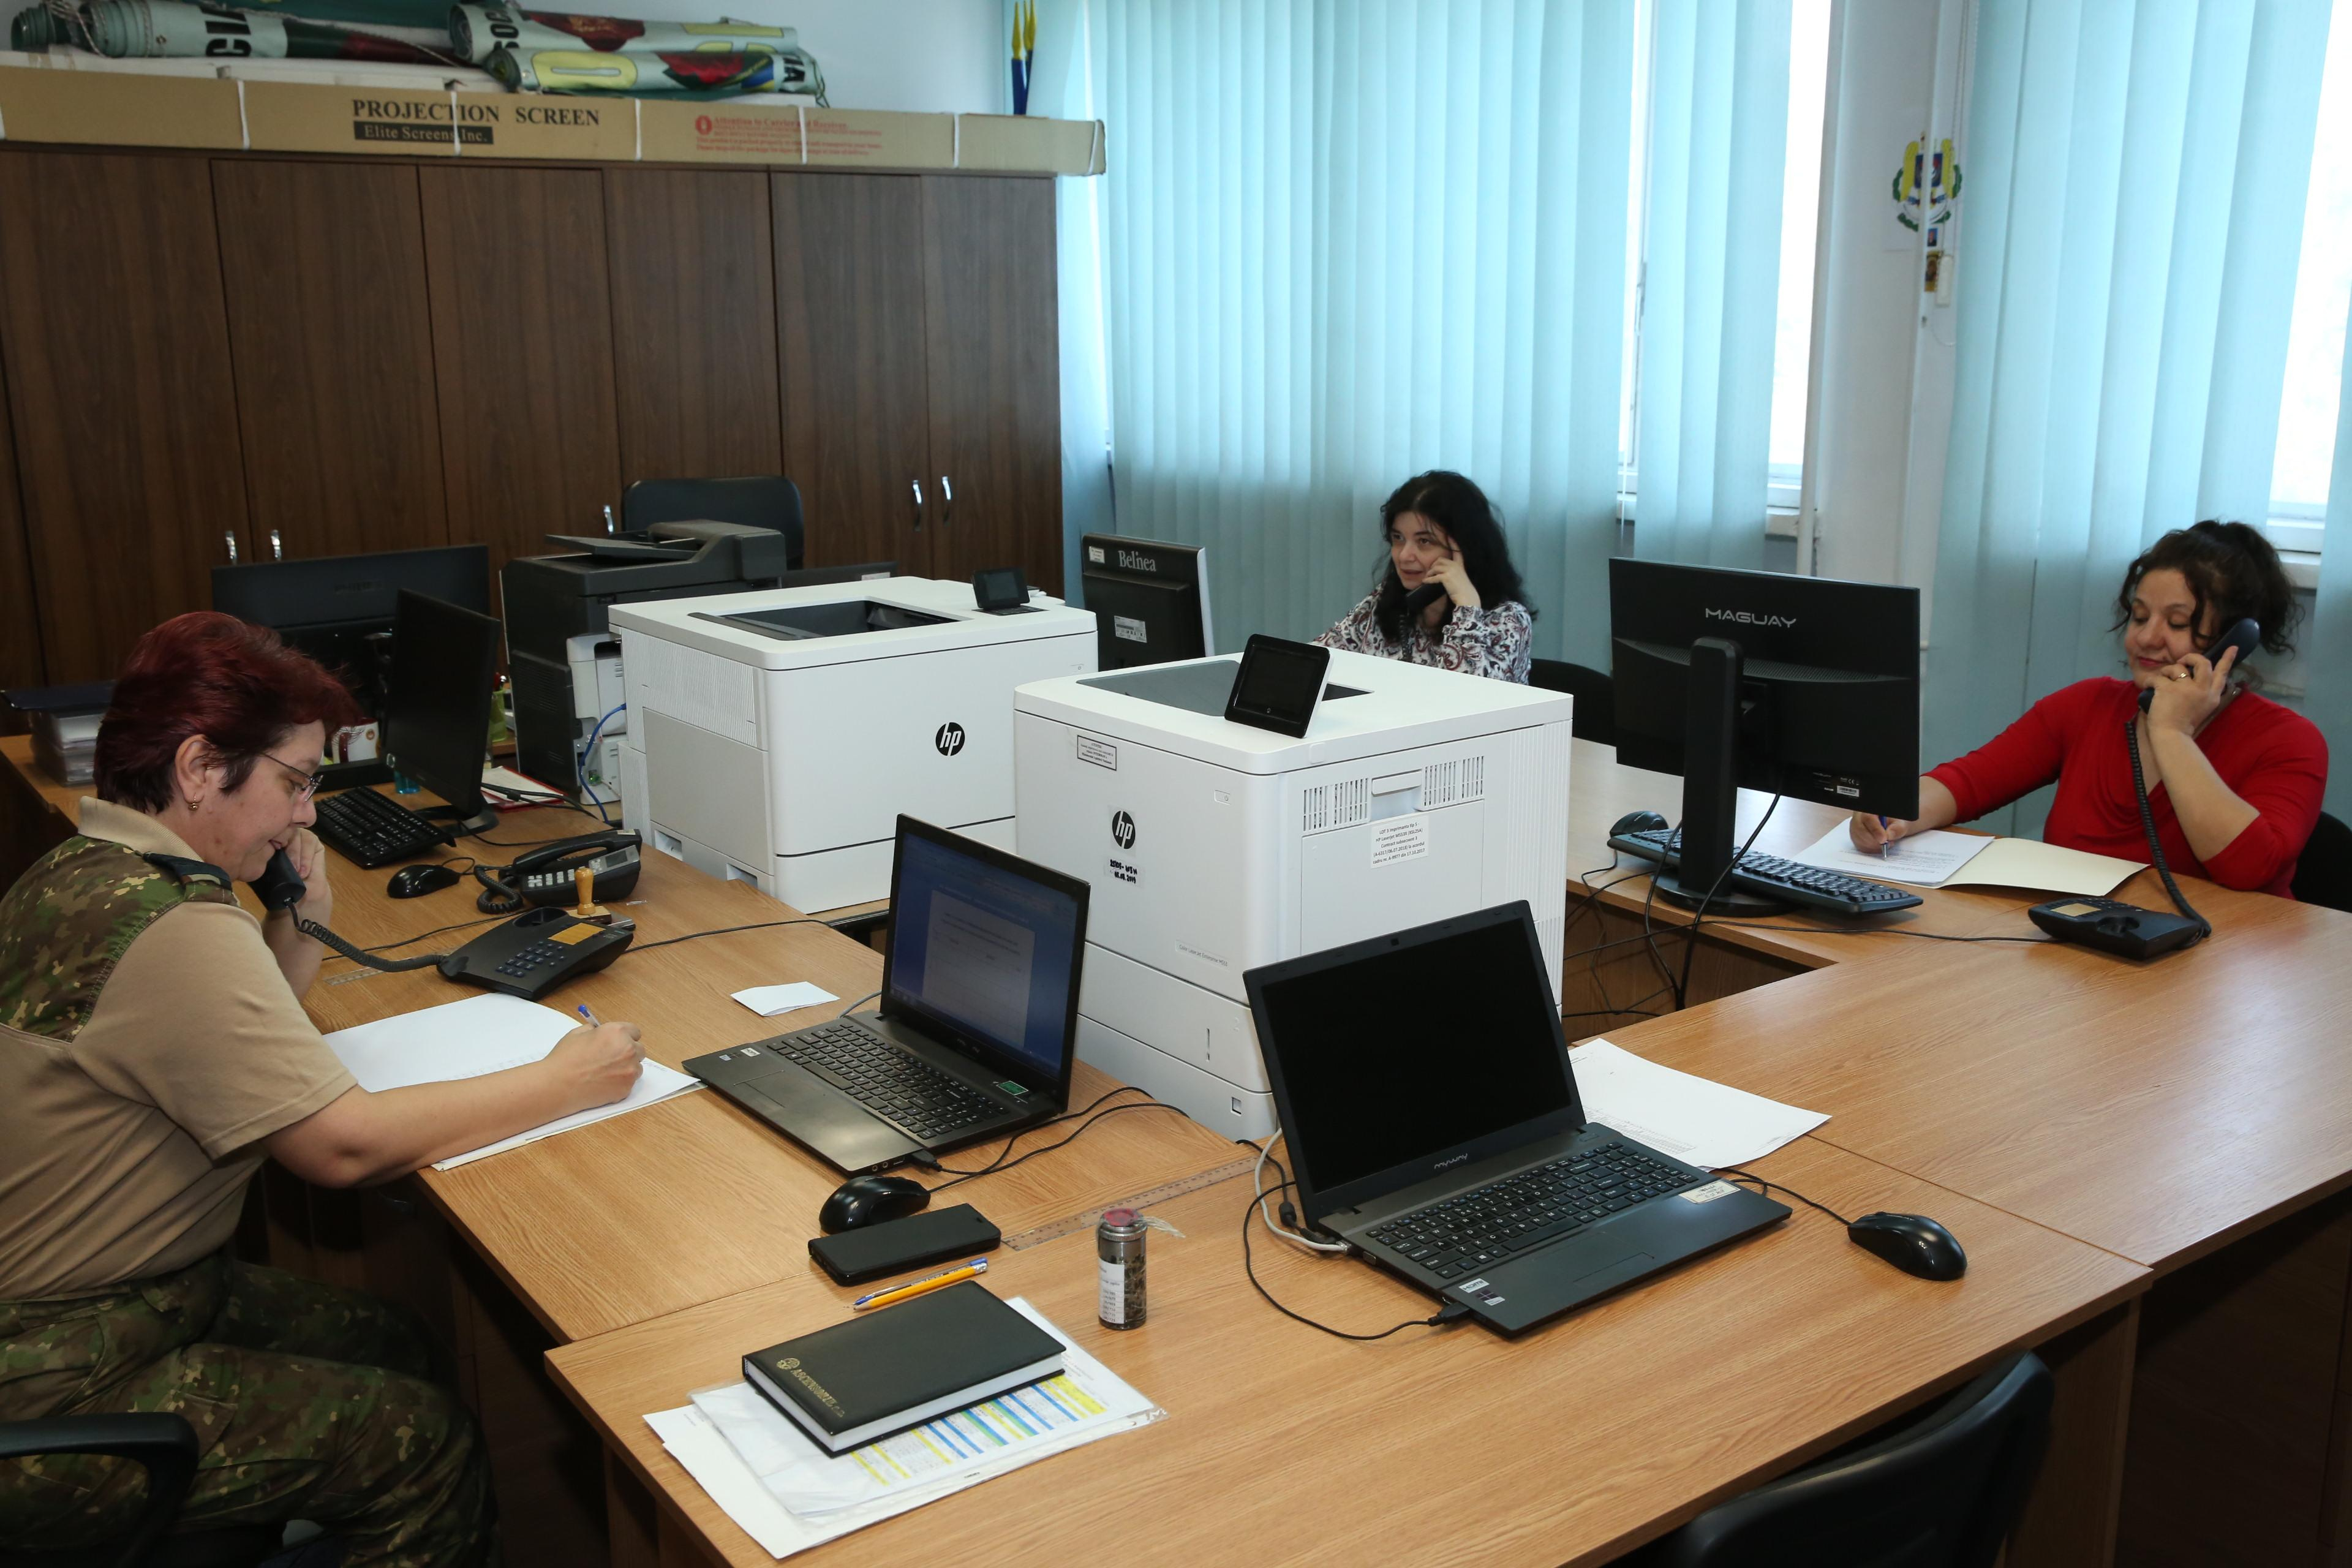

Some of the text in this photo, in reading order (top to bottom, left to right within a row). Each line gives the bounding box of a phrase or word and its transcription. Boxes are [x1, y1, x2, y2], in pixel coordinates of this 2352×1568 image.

[352, 99, 599, 126] PROJECTION SCREEN
[364, 126, 488, 142] Elite Screens Inc.
[1118, 550, 1157, 572] Belinea
[1706, 608, 1796, 629] MAGUAY
[938, 722, 962, 756] hp
[1114, 810, 1134, 850] hp
